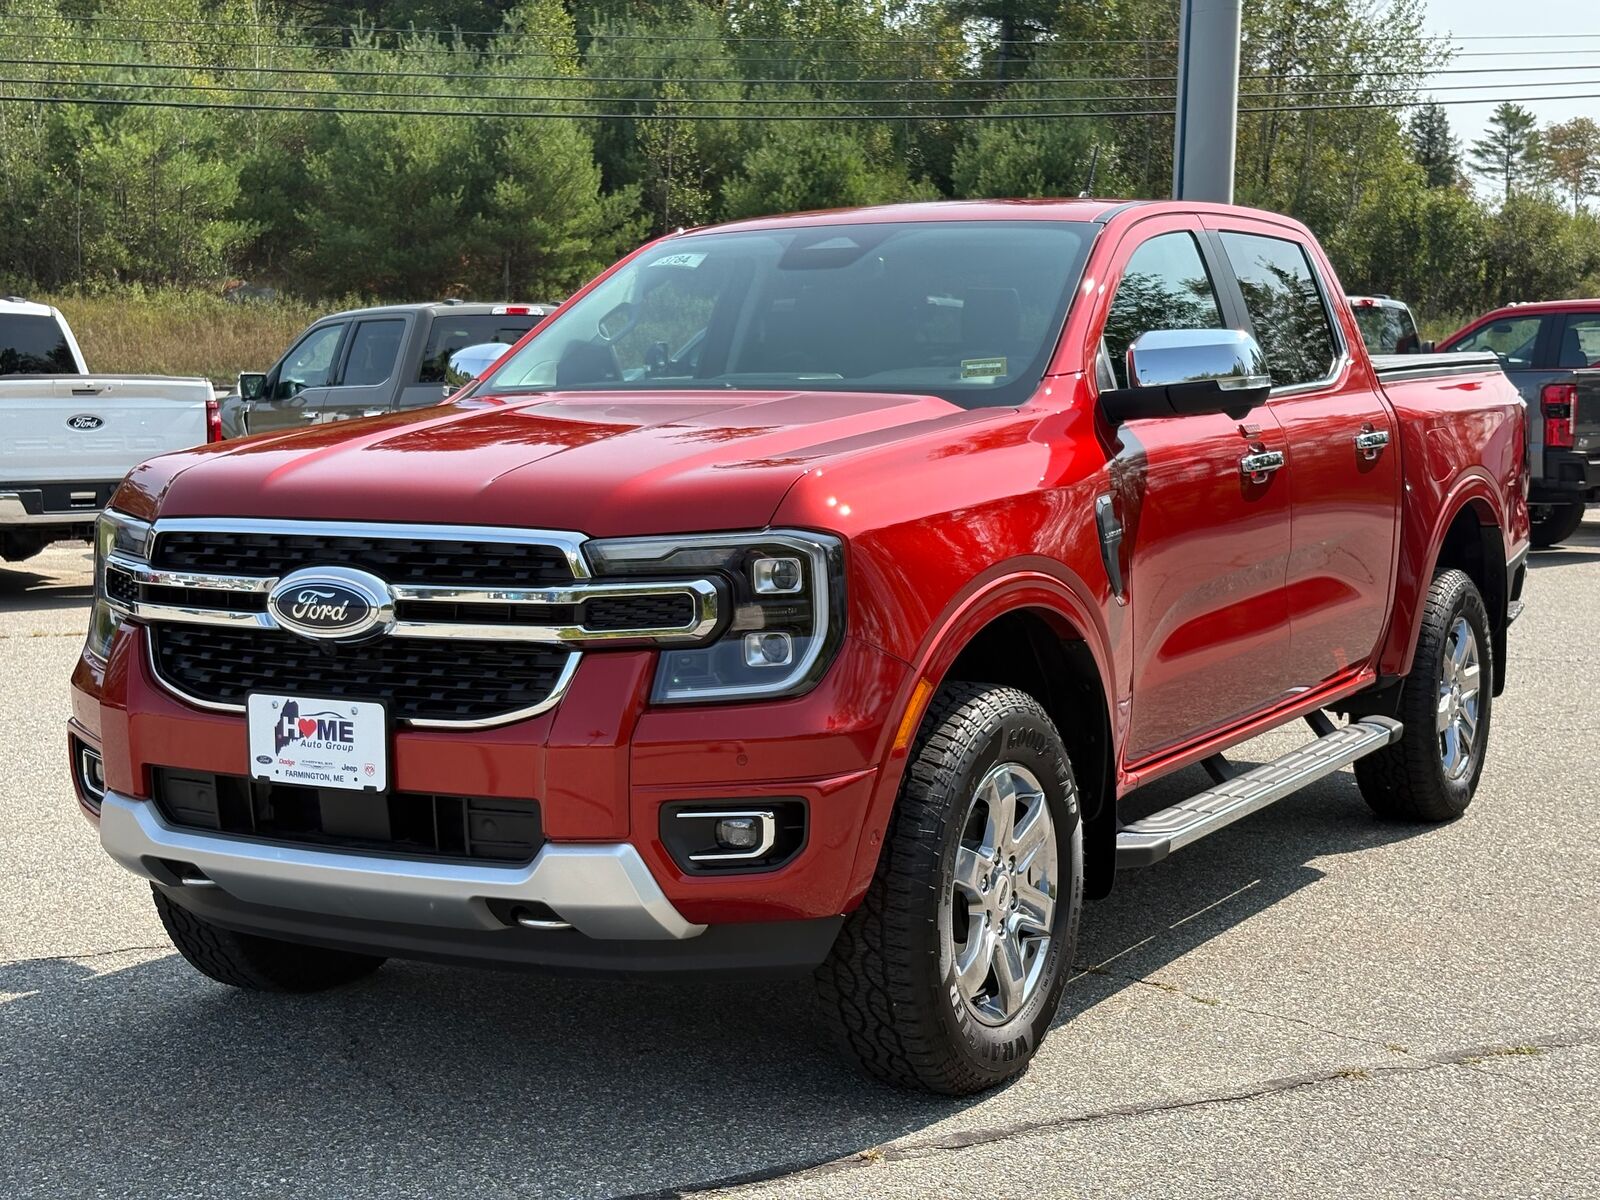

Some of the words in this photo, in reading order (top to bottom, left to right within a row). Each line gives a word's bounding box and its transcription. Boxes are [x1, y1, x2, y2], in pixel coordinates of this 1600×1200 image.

[73, 416, 98, 428] Ford
[292, 589, 349, 621] Ford
[300, 739, 322, 749] Auto
[325, 742, 354, 752] Group
[278, 758, 296, 767] Dodge
[341, 764, 358, 773] Jeep
[285, 769, 332, 782] FARMINGTON,
[333, 774, 344, 782] ME
